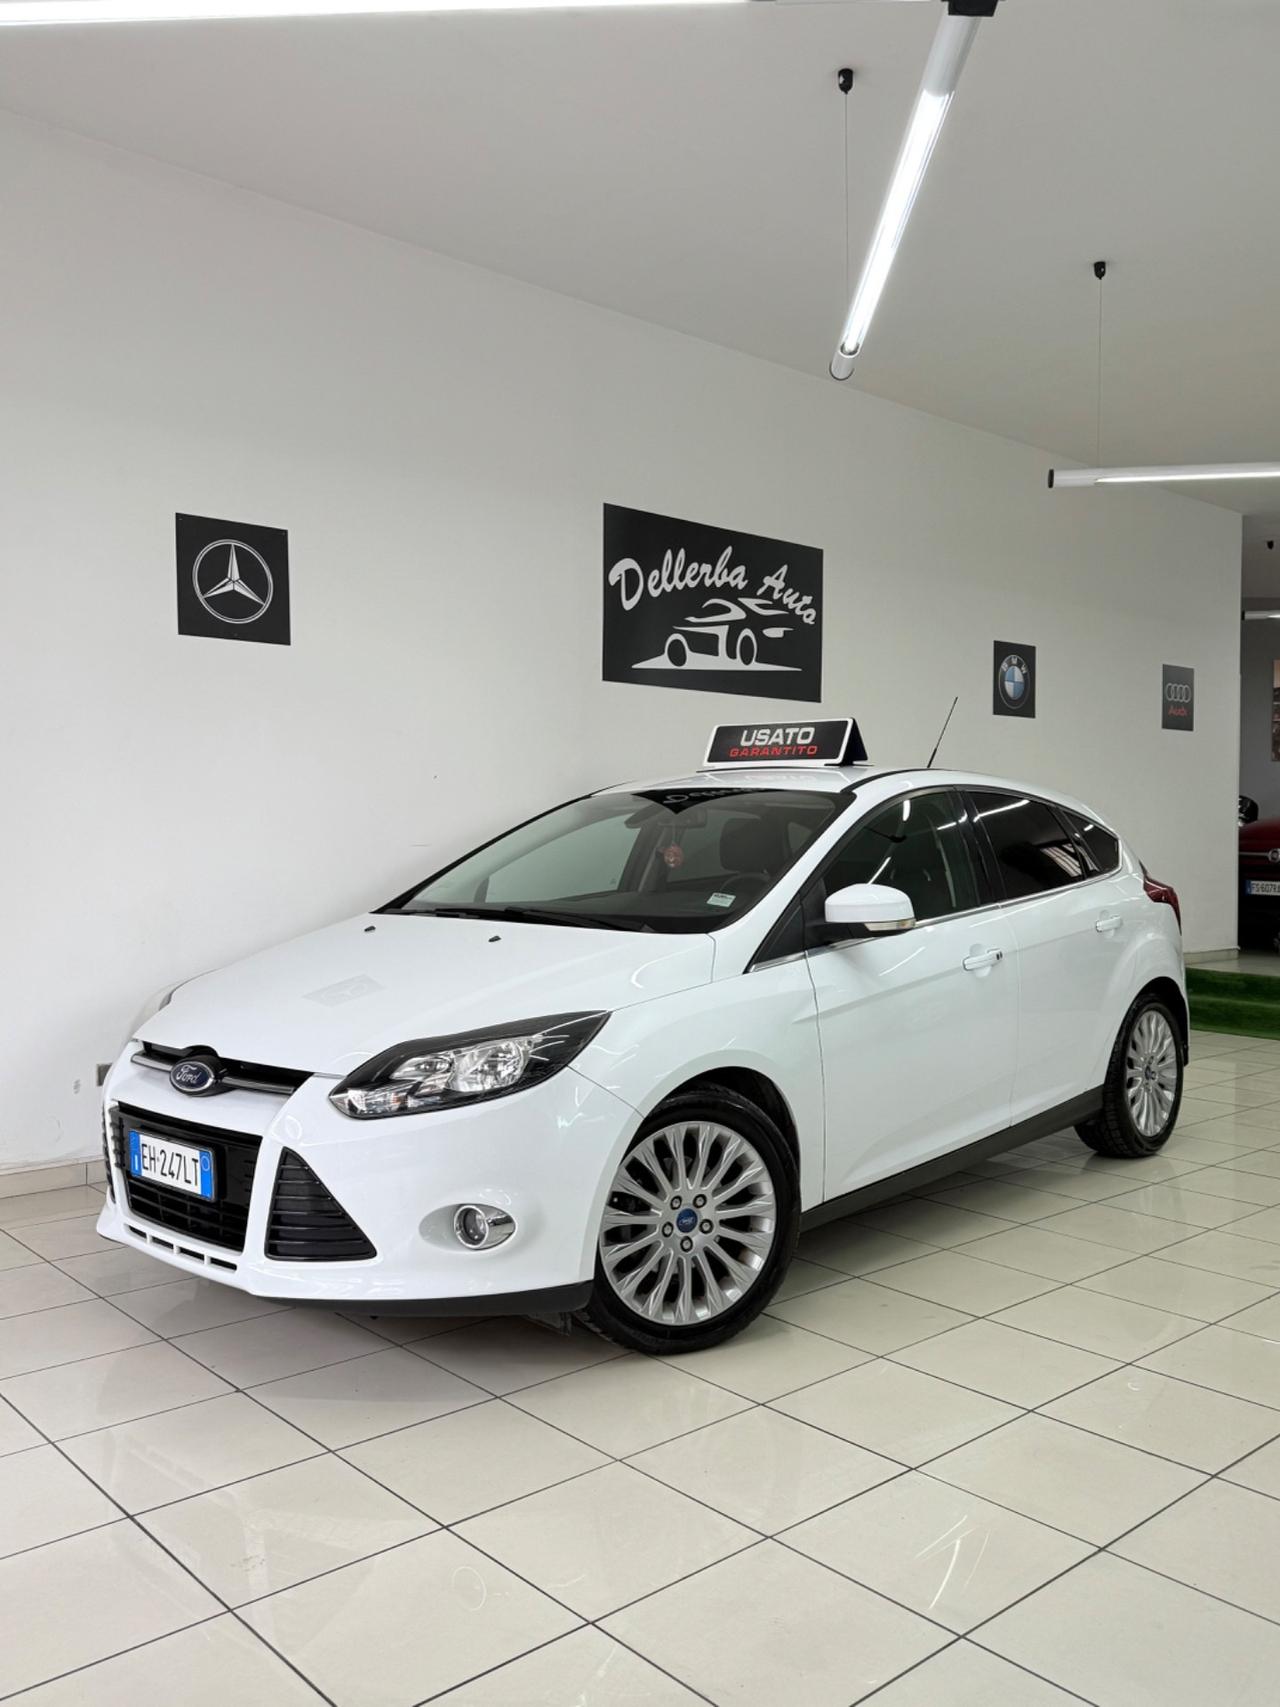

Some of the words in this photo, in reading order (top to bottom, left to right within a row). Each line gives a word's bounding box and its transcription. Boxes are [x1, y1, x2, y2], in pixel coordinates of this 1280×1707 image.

[608, 545, 749, 611] Dellerba
[756, 564, 817, 625] Auto
[740, 727, 815, 747] USATO
[729, 745, 818, 758] GARANTITO
[175, 1064, 202, 1084] Ford
